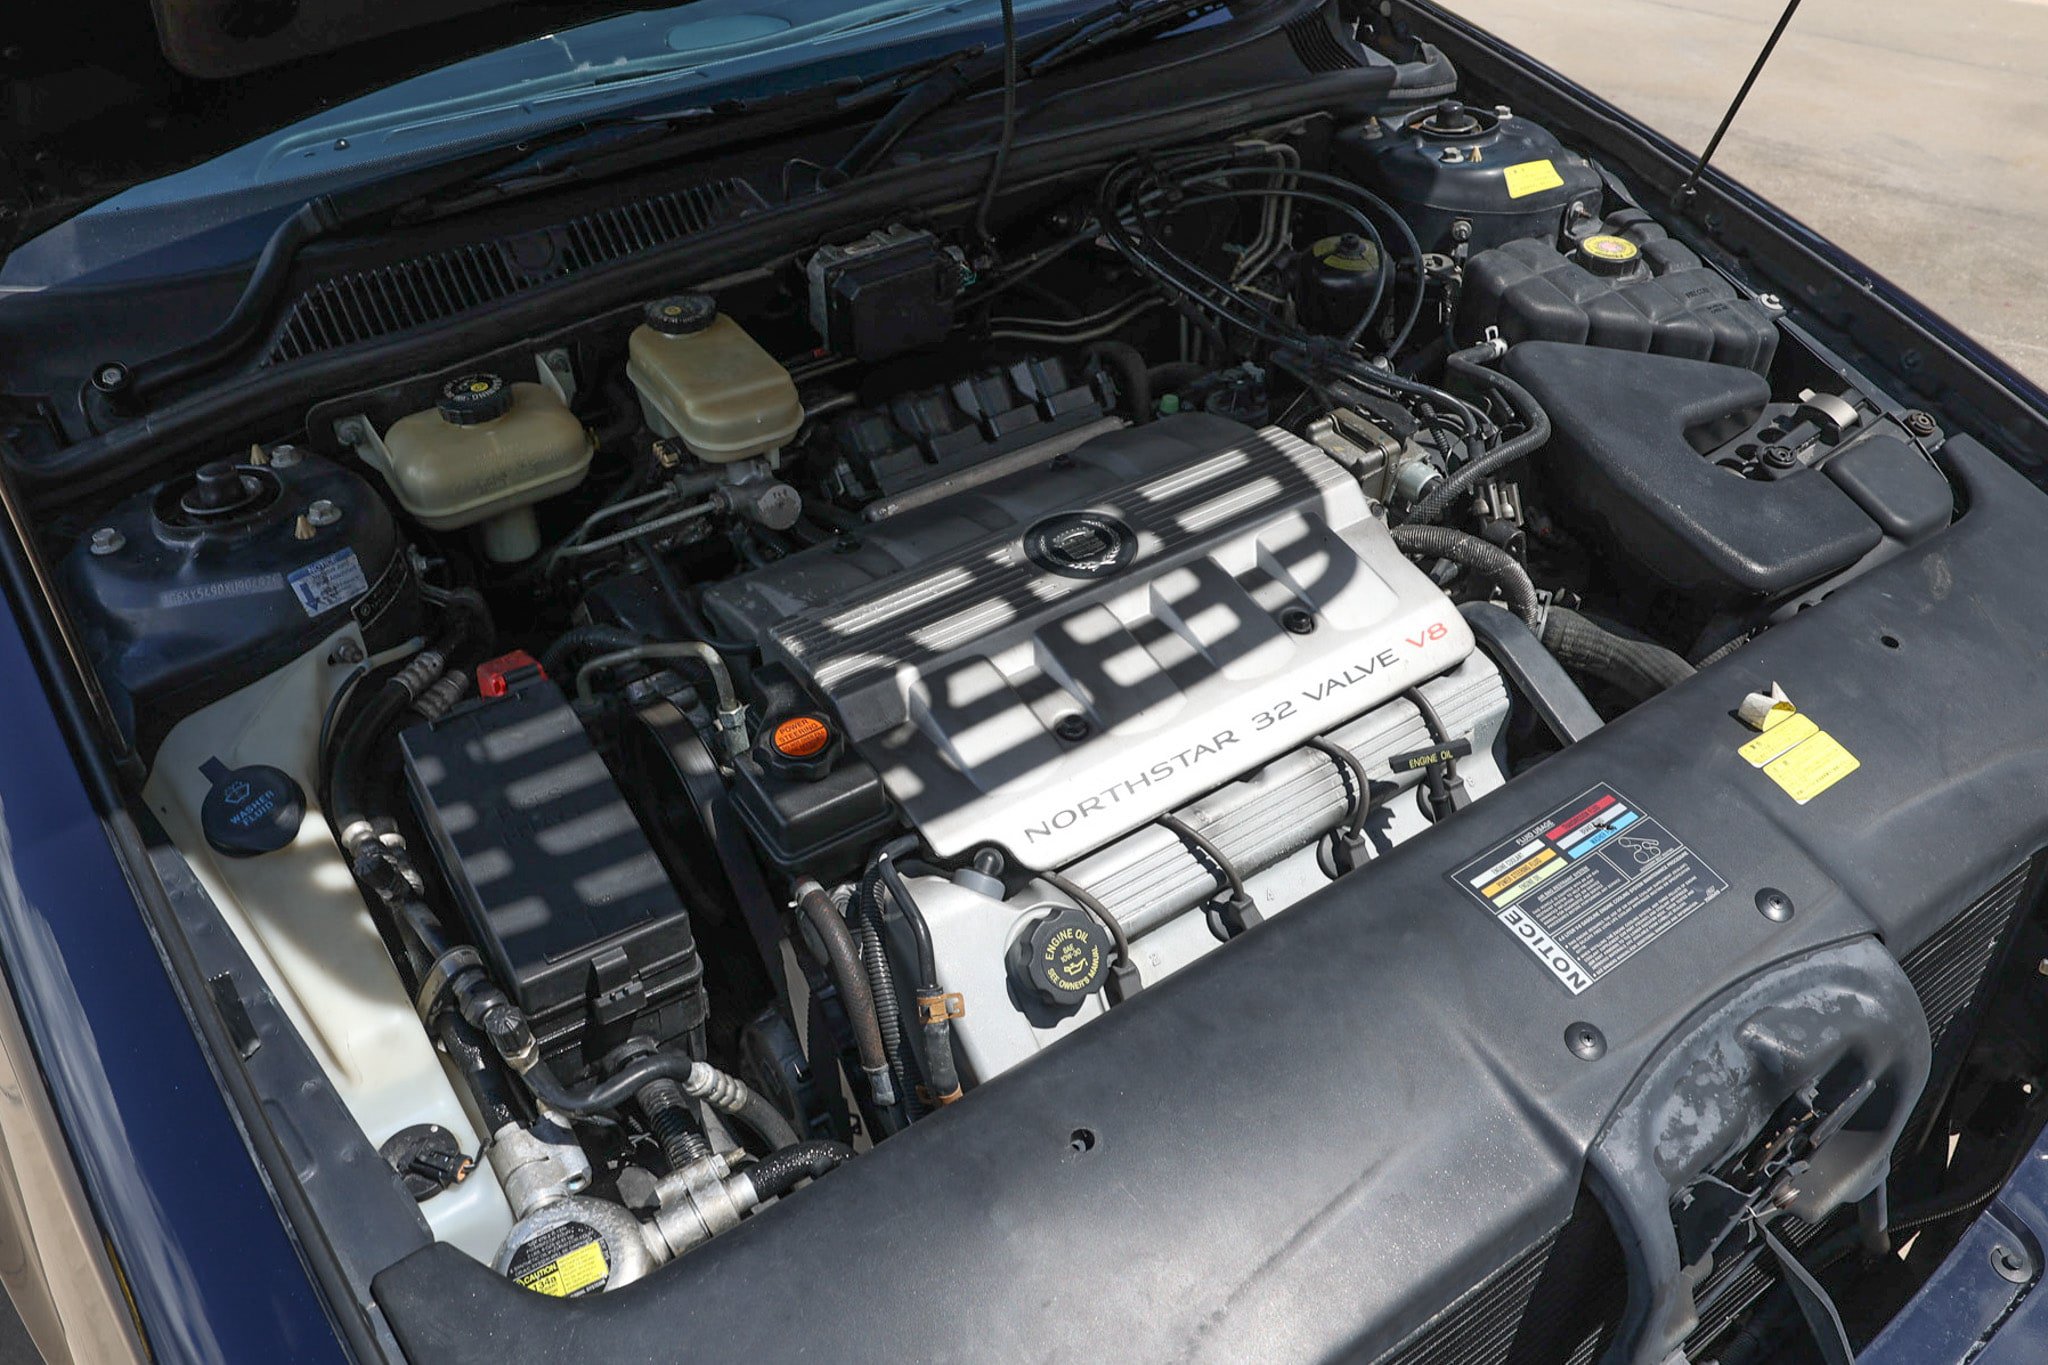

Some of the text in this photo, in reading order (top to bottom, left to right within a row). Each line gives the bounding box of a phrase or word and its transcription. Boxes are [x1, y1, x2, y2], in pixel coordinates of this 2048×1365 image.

[779, 723, 818, 742] STEERING
[780, 719, 808, 735] POWER
[1023, 622, 1449, 843] NORTHSTAR 32 VALVE V8
[1408, 750, 1453, 769] ENGINE OIL
[229, 790, 275, 824] WASHER
[242, 801, 274, 826] FLUID
[1516, 820, 1554, 846] FLUID USAGE
[1491, 852, 1525, 875] ENGINE COOLANT
[1497, 858, 1542, 889] POWER STEERING FLUID
[1519, 874, 1542, 891] ENGINE OIL
[1045, 928, 1090, 961] ENGINE OIL
[1503, 909, 1587, 989] NOTICE
[1047, 945, 1100, 991] SEE OWNER'S MANUAL
[523, 1263, 557, 1284] CAUTION
